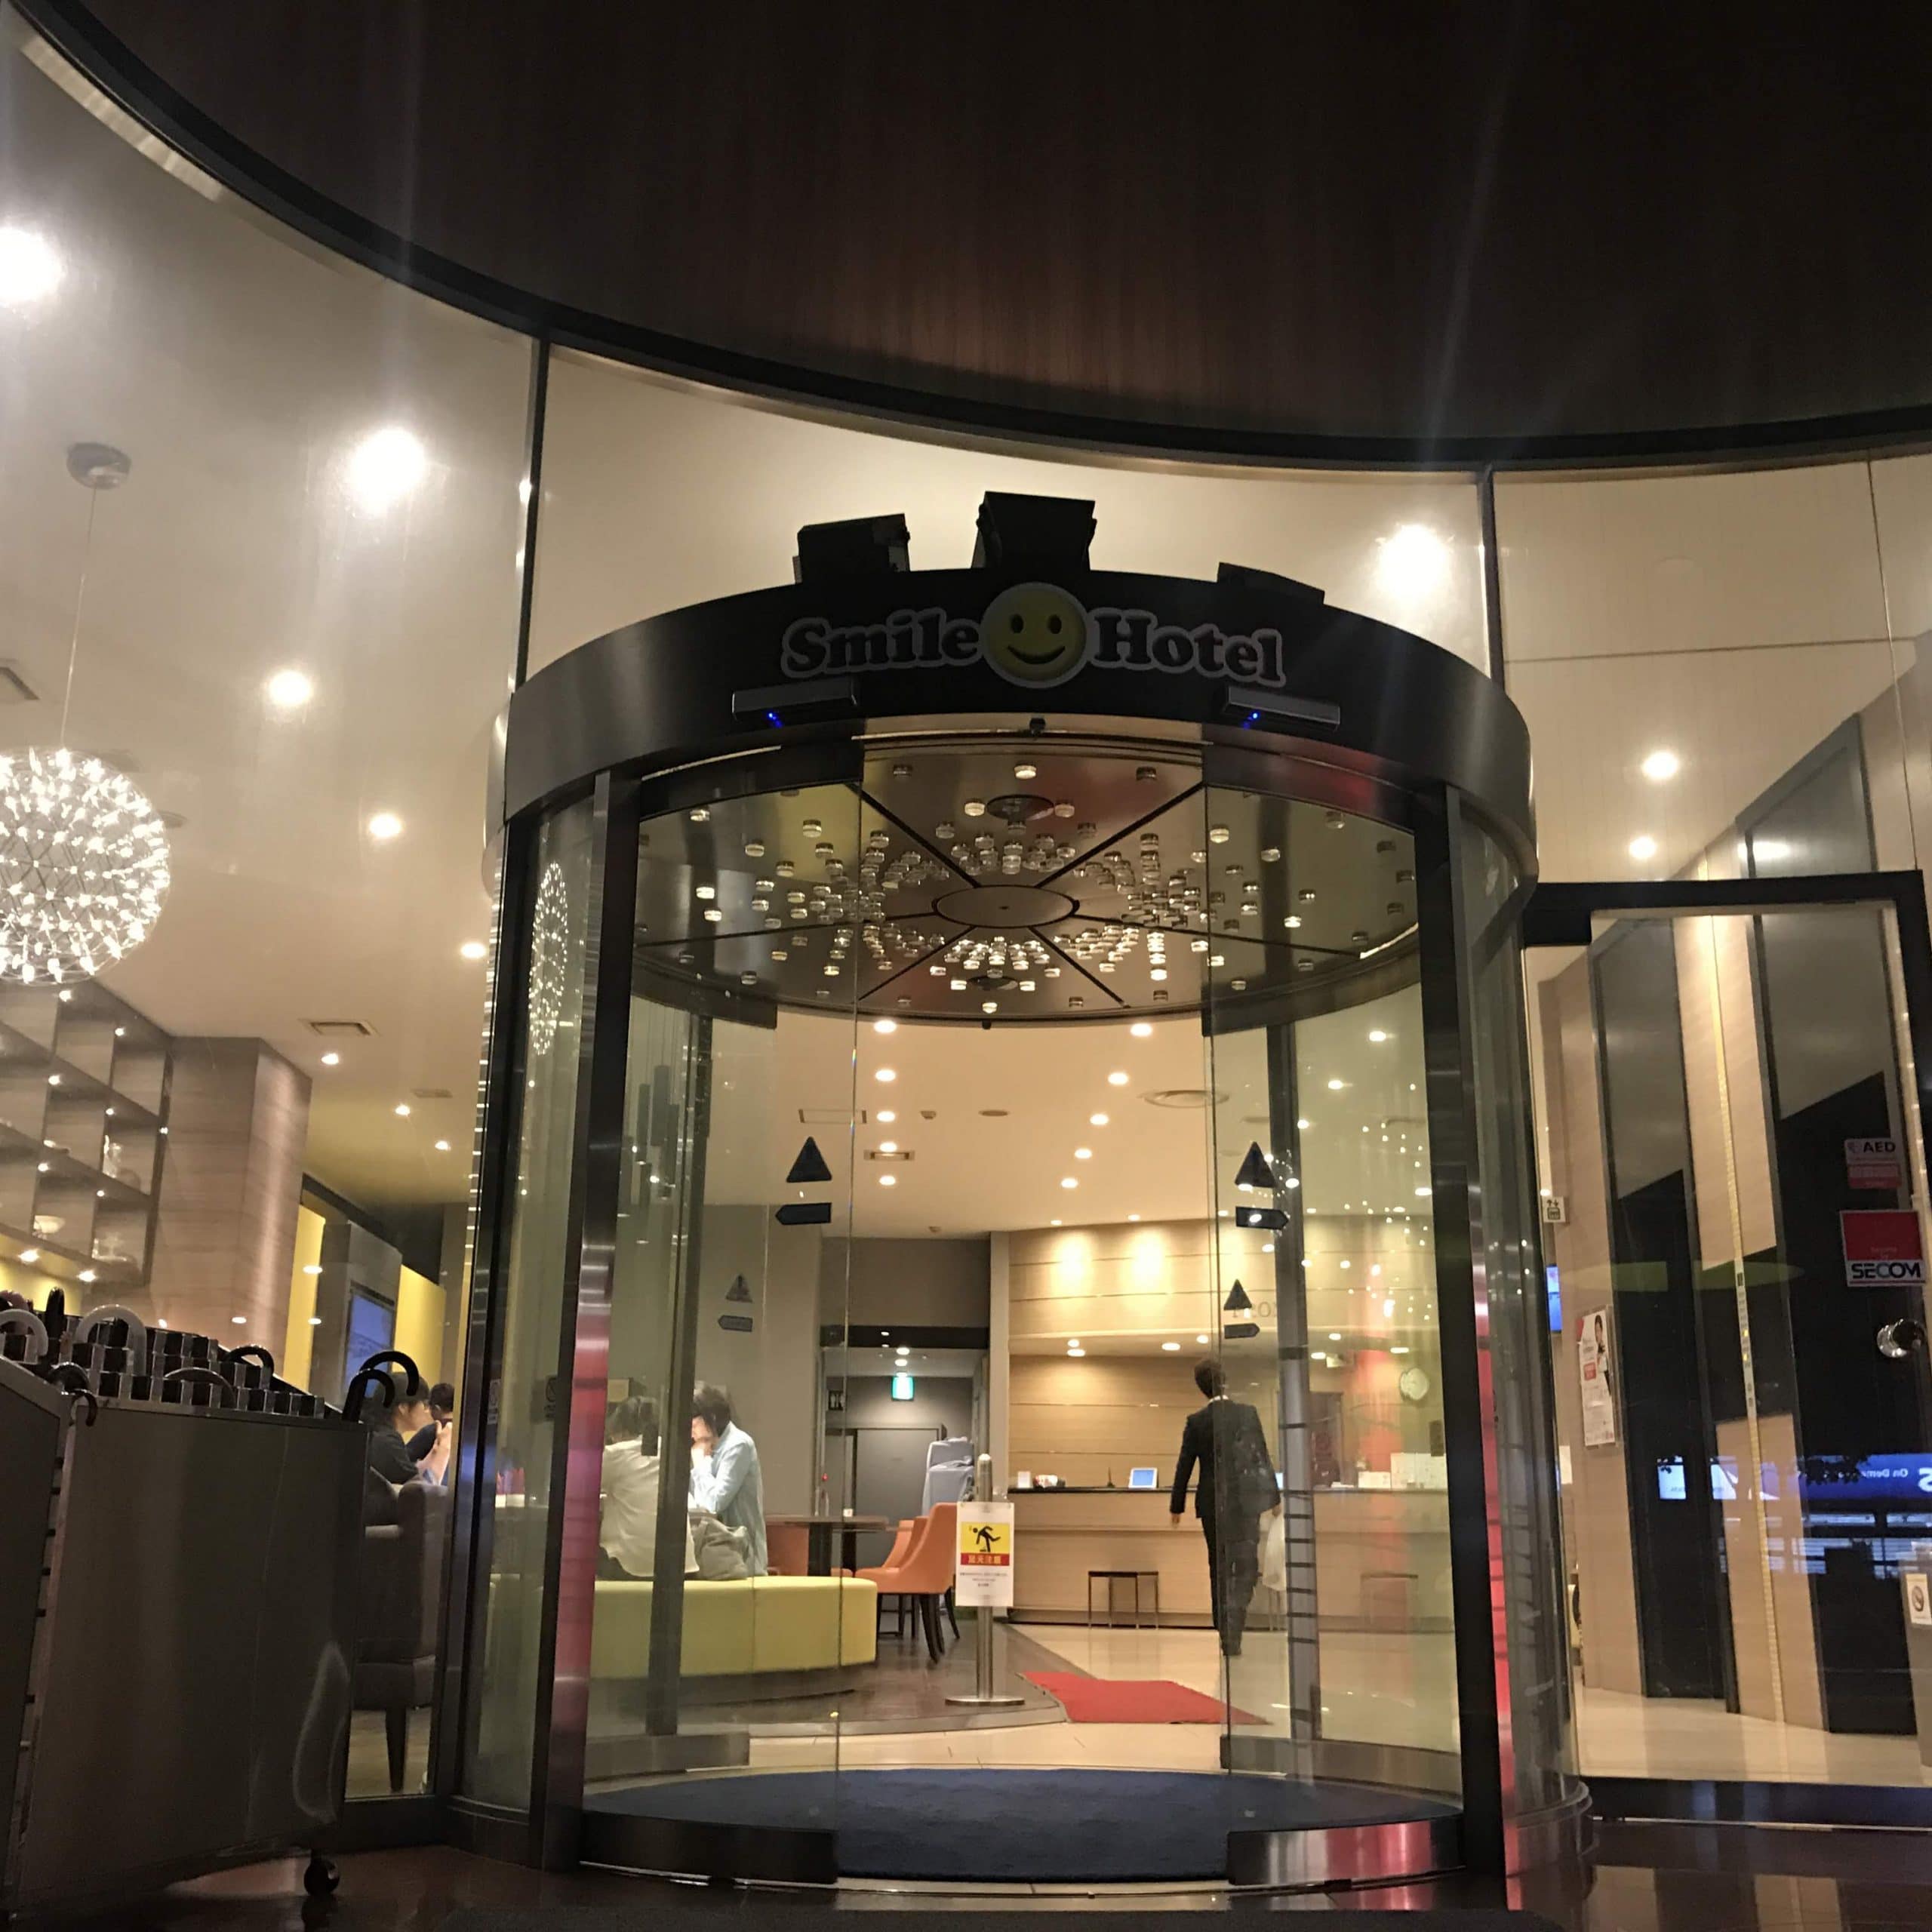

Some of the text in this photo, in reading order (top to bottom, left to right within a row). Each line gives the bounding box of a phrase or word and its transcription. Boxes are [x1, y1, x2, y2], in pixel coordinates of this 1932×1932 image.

[783, 608, 1286, 686] Smile Hotel
[1863, 1141, 1896, 1153] AED
[1851, 1262, 1921, 1279] SECOM
